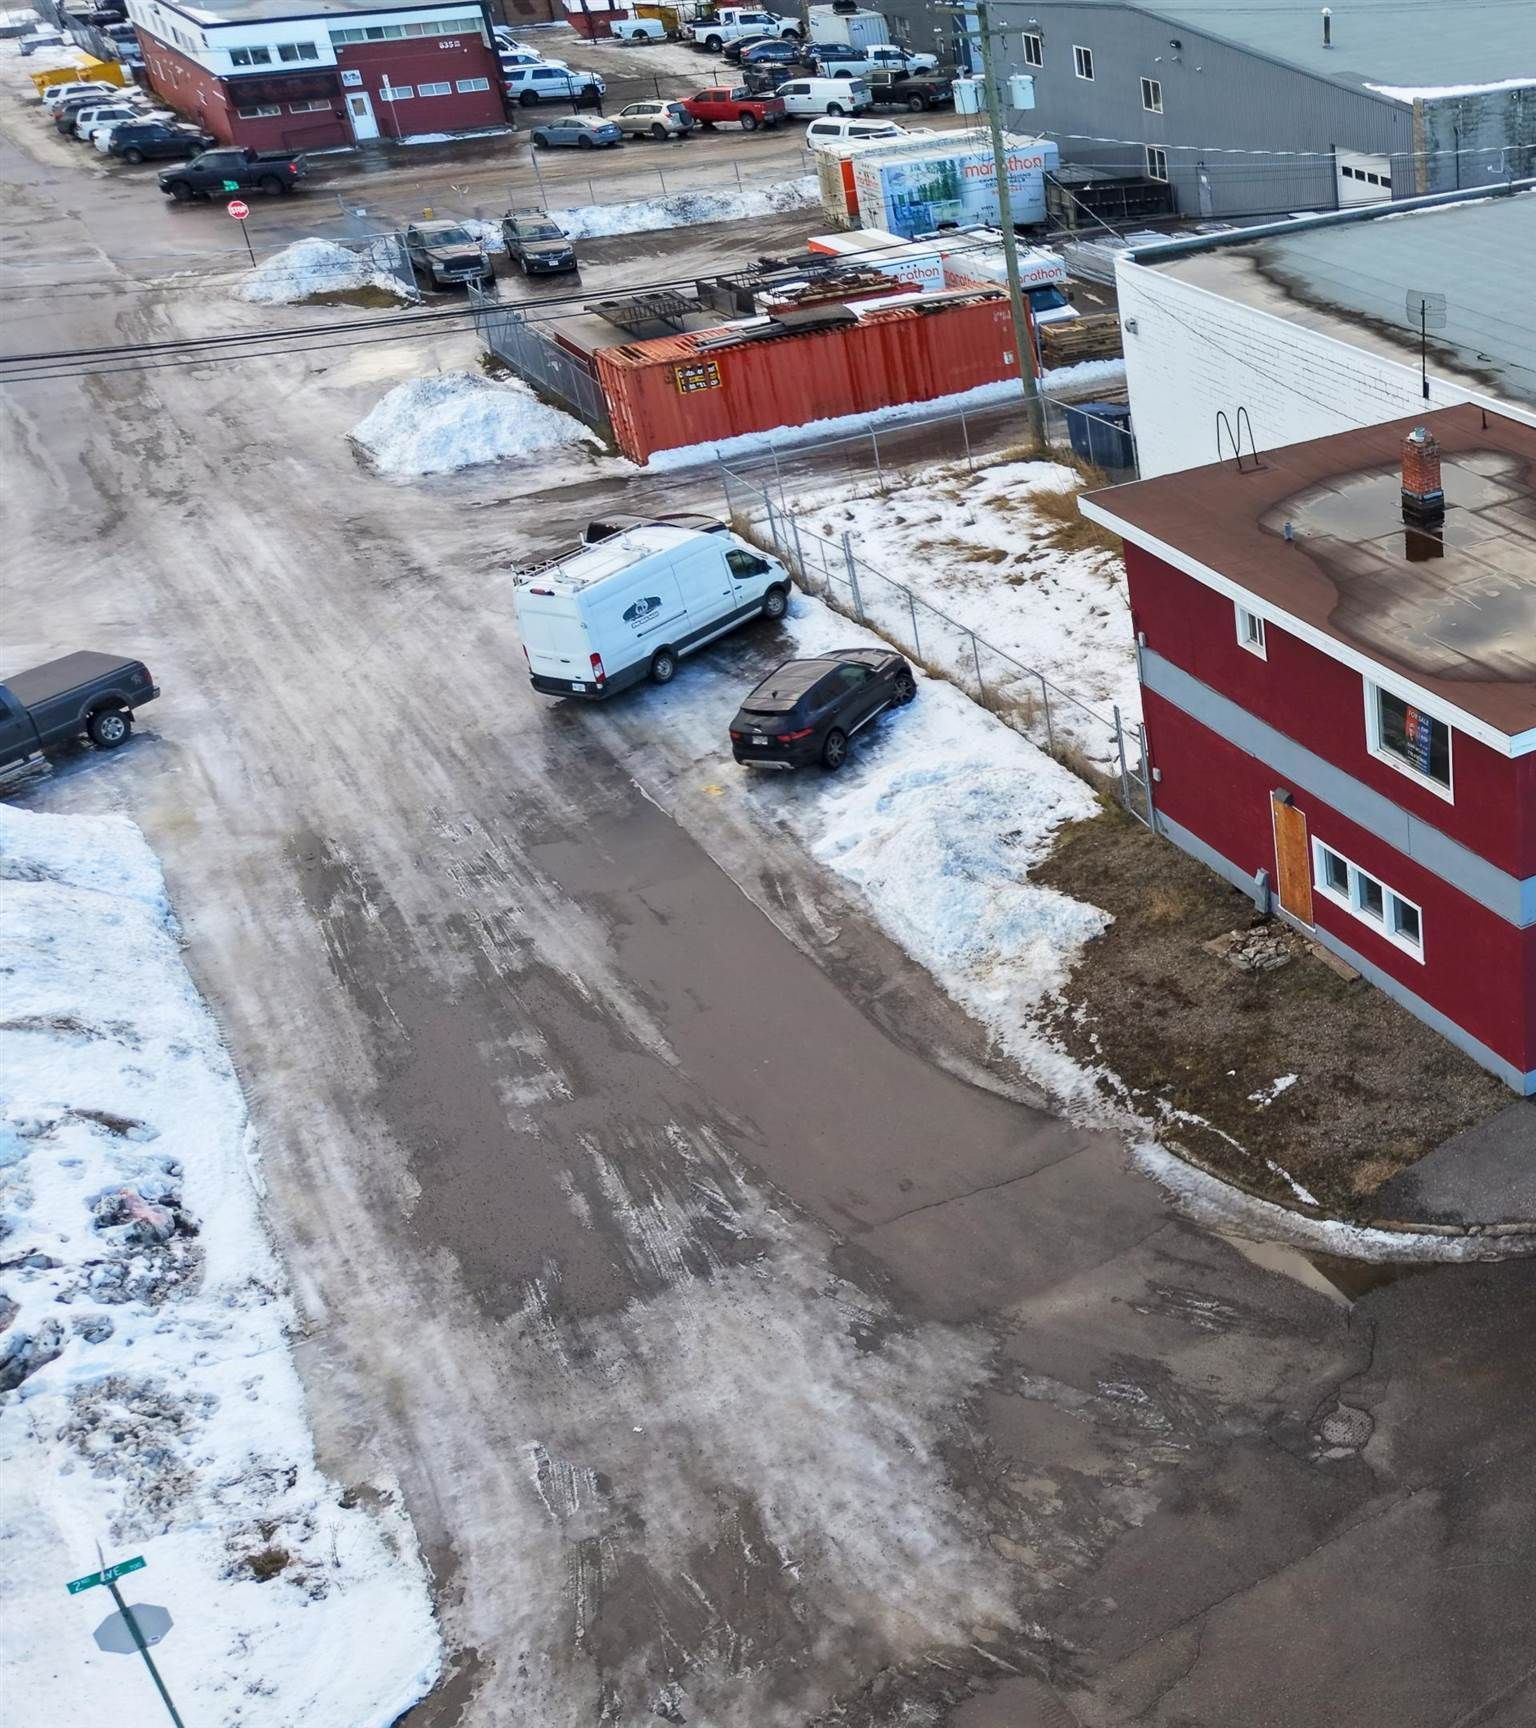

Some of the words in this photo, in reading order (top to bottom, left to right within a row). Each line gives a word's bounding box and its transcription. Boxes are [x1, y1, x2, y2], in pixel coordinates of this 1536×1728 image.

[964, 154, 1042, 177] marthon
[230, 205, 248, 215] STOP
[898, 267, 940, 281] rathon
